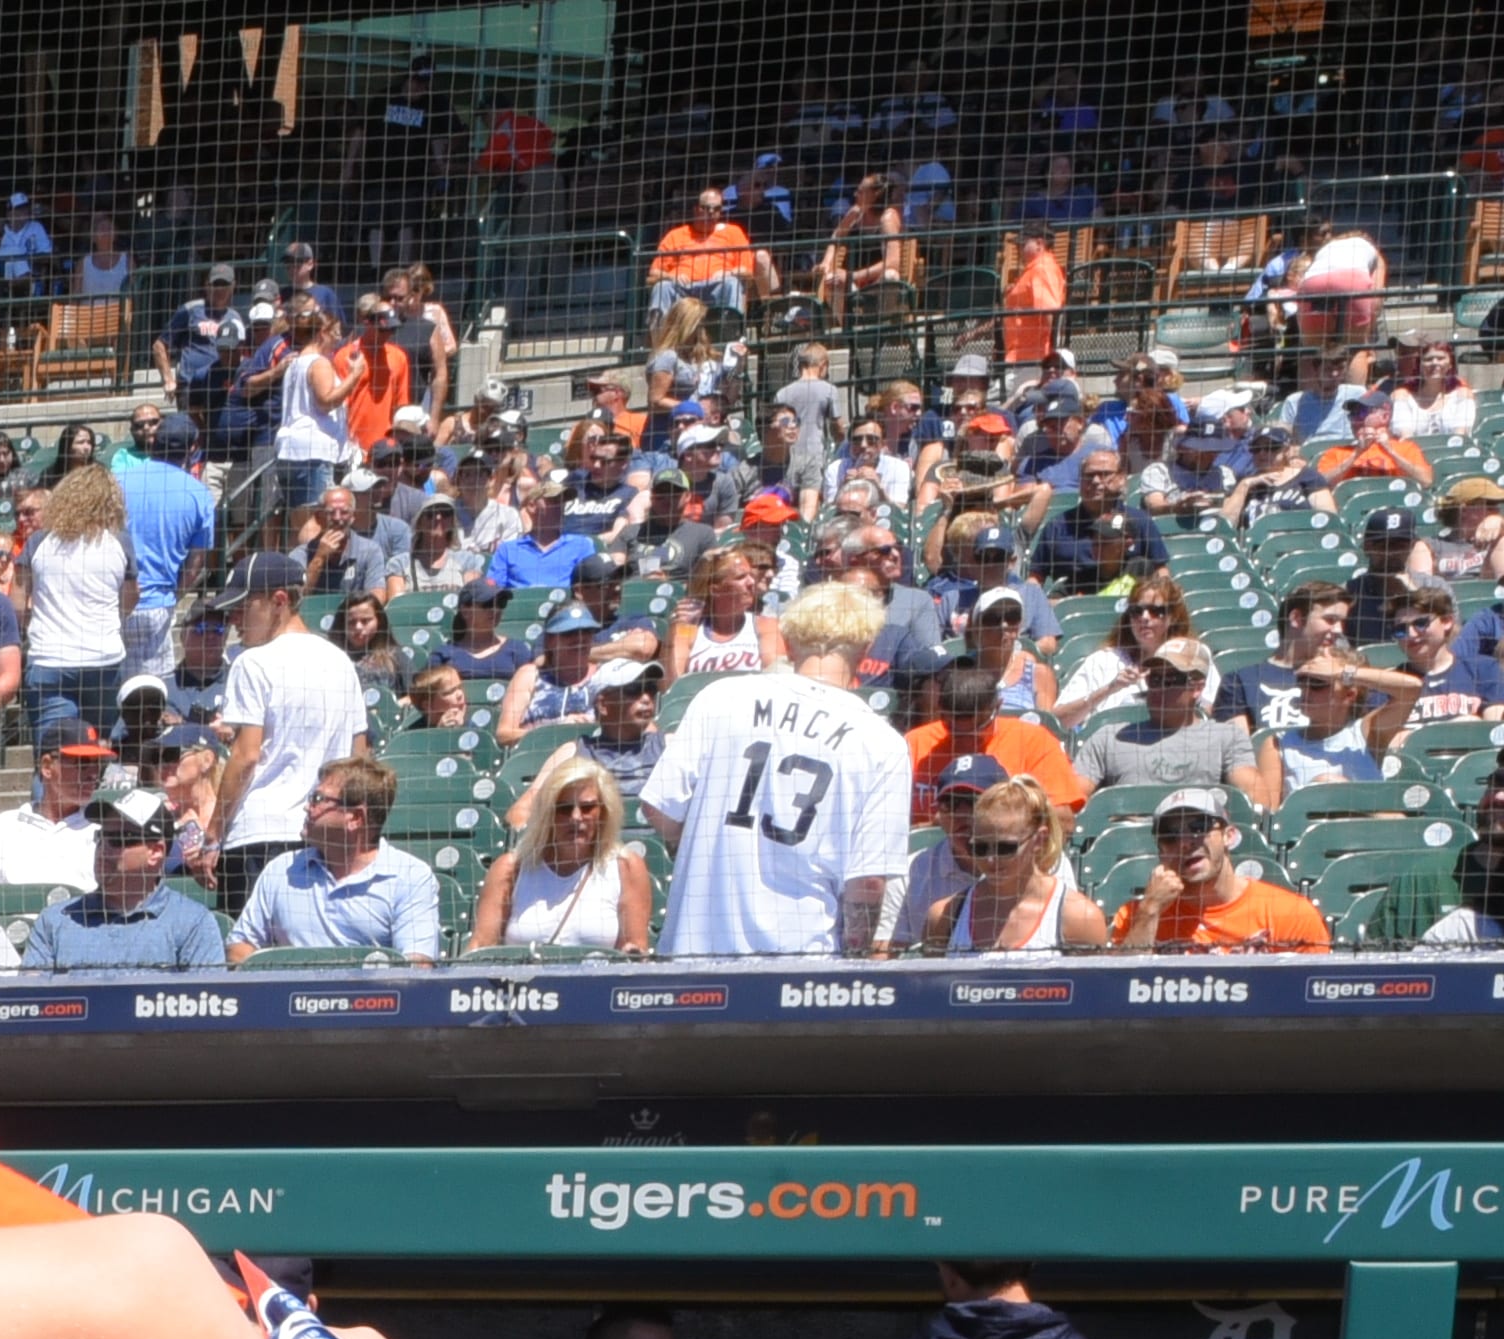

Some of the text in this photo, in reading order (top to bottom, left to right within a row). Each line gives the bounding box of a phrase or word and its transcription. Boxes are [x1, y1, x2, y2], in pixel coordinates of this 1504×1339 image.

[752, 698, 855, 752] MACK
[724, 740, 834, 847] 13
[616, 988, 724, 1010] tigers.com
[780, 981, 896, 1009] bitbits
[955, 982, 1069, 1003] tigers.com
[1128, 976, 1249, 1004] bitbits
[1311, 978, 1429, 999] tigers.com
[134, 993, 240, 1019] bitbits
[293, 994, 397, 1016] tigers.com
[545, 1173, 918, 1231] tigers.com
[1240, 1185, 1360, 1214] PURE
